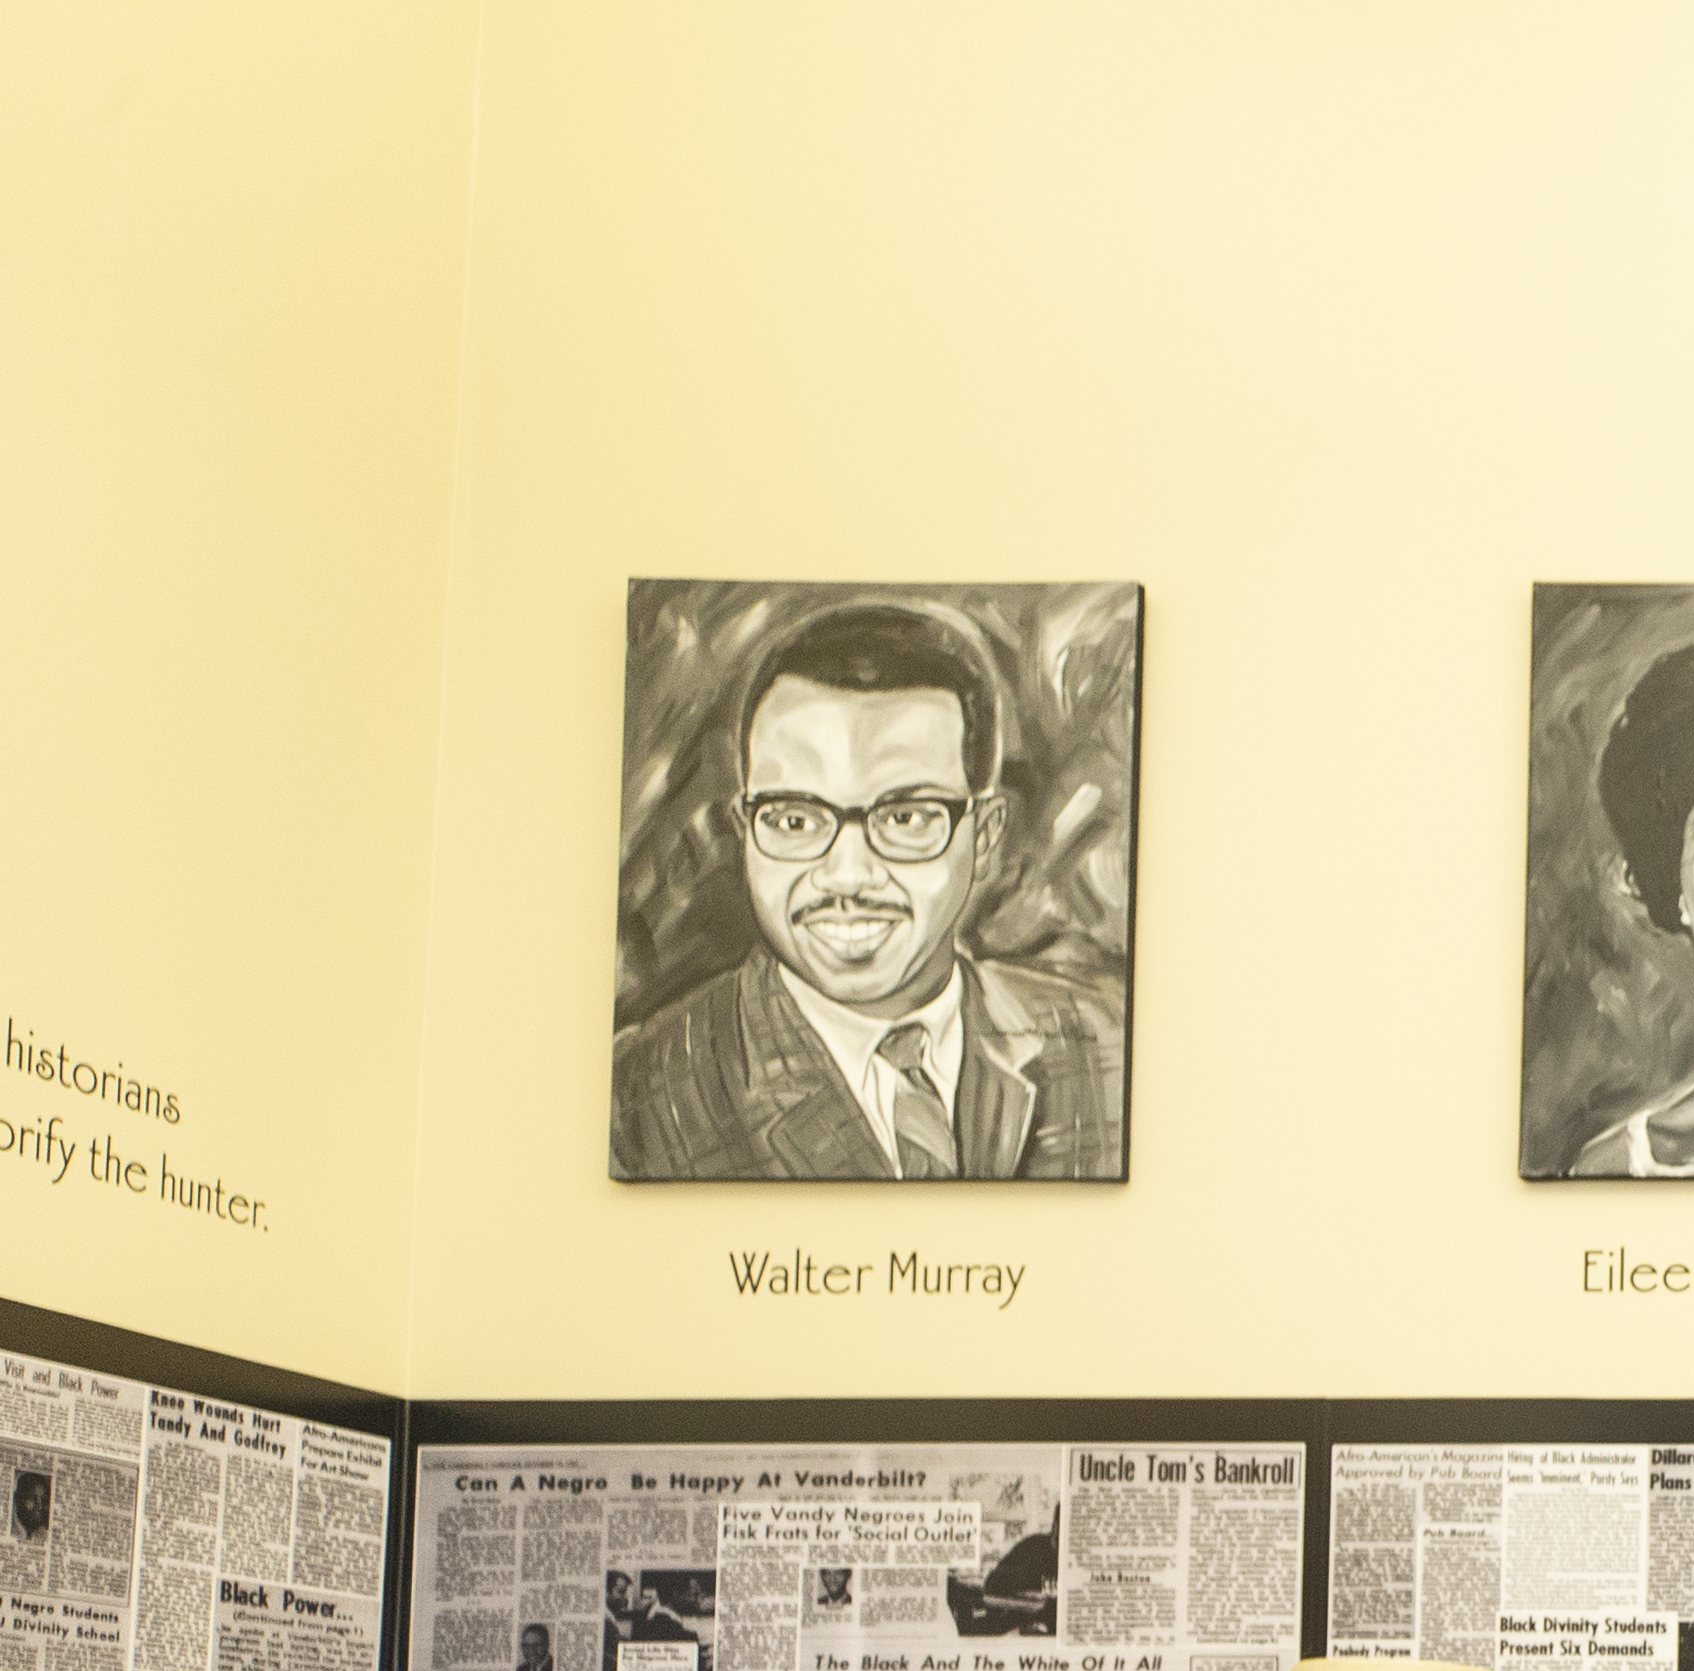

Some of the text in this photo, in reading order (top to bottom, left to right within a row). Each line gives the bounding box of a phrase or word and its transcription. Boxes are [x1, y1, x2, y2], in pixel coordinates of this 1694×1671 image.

[6, 1017, 181, 1125] historians
[89, 1134, 148, 1193] the
[160, 1152, 269, 1233] hunter.
[729, 1248, 1025, 1309] Walter Murray
[1079, 1453, 1294, 1484] Uncle Tom's Bankroll
[454, 1470, 927, 1494] Can A Negro Be Happy At Vanderbilt?
[1649, 1473, 1692, 1491] Plans
[220, 1581, 269, 1609] Black
[1499, 1617, 1668, 1637] Black Divinity Students
[1499, 1640, 1654, 1657] Present Six Demands
[815, 1655, 850, 1671] The
[860, 1655, 909, 1671] Black
[920, 1655, 961, 1671] And
[973, 1655, 1006, 1671] The
[1018, 1656, 1070, 1671] White
[1113, 1657, 1126, 1671] It
[1135, 1656, 1163, 1671] All
